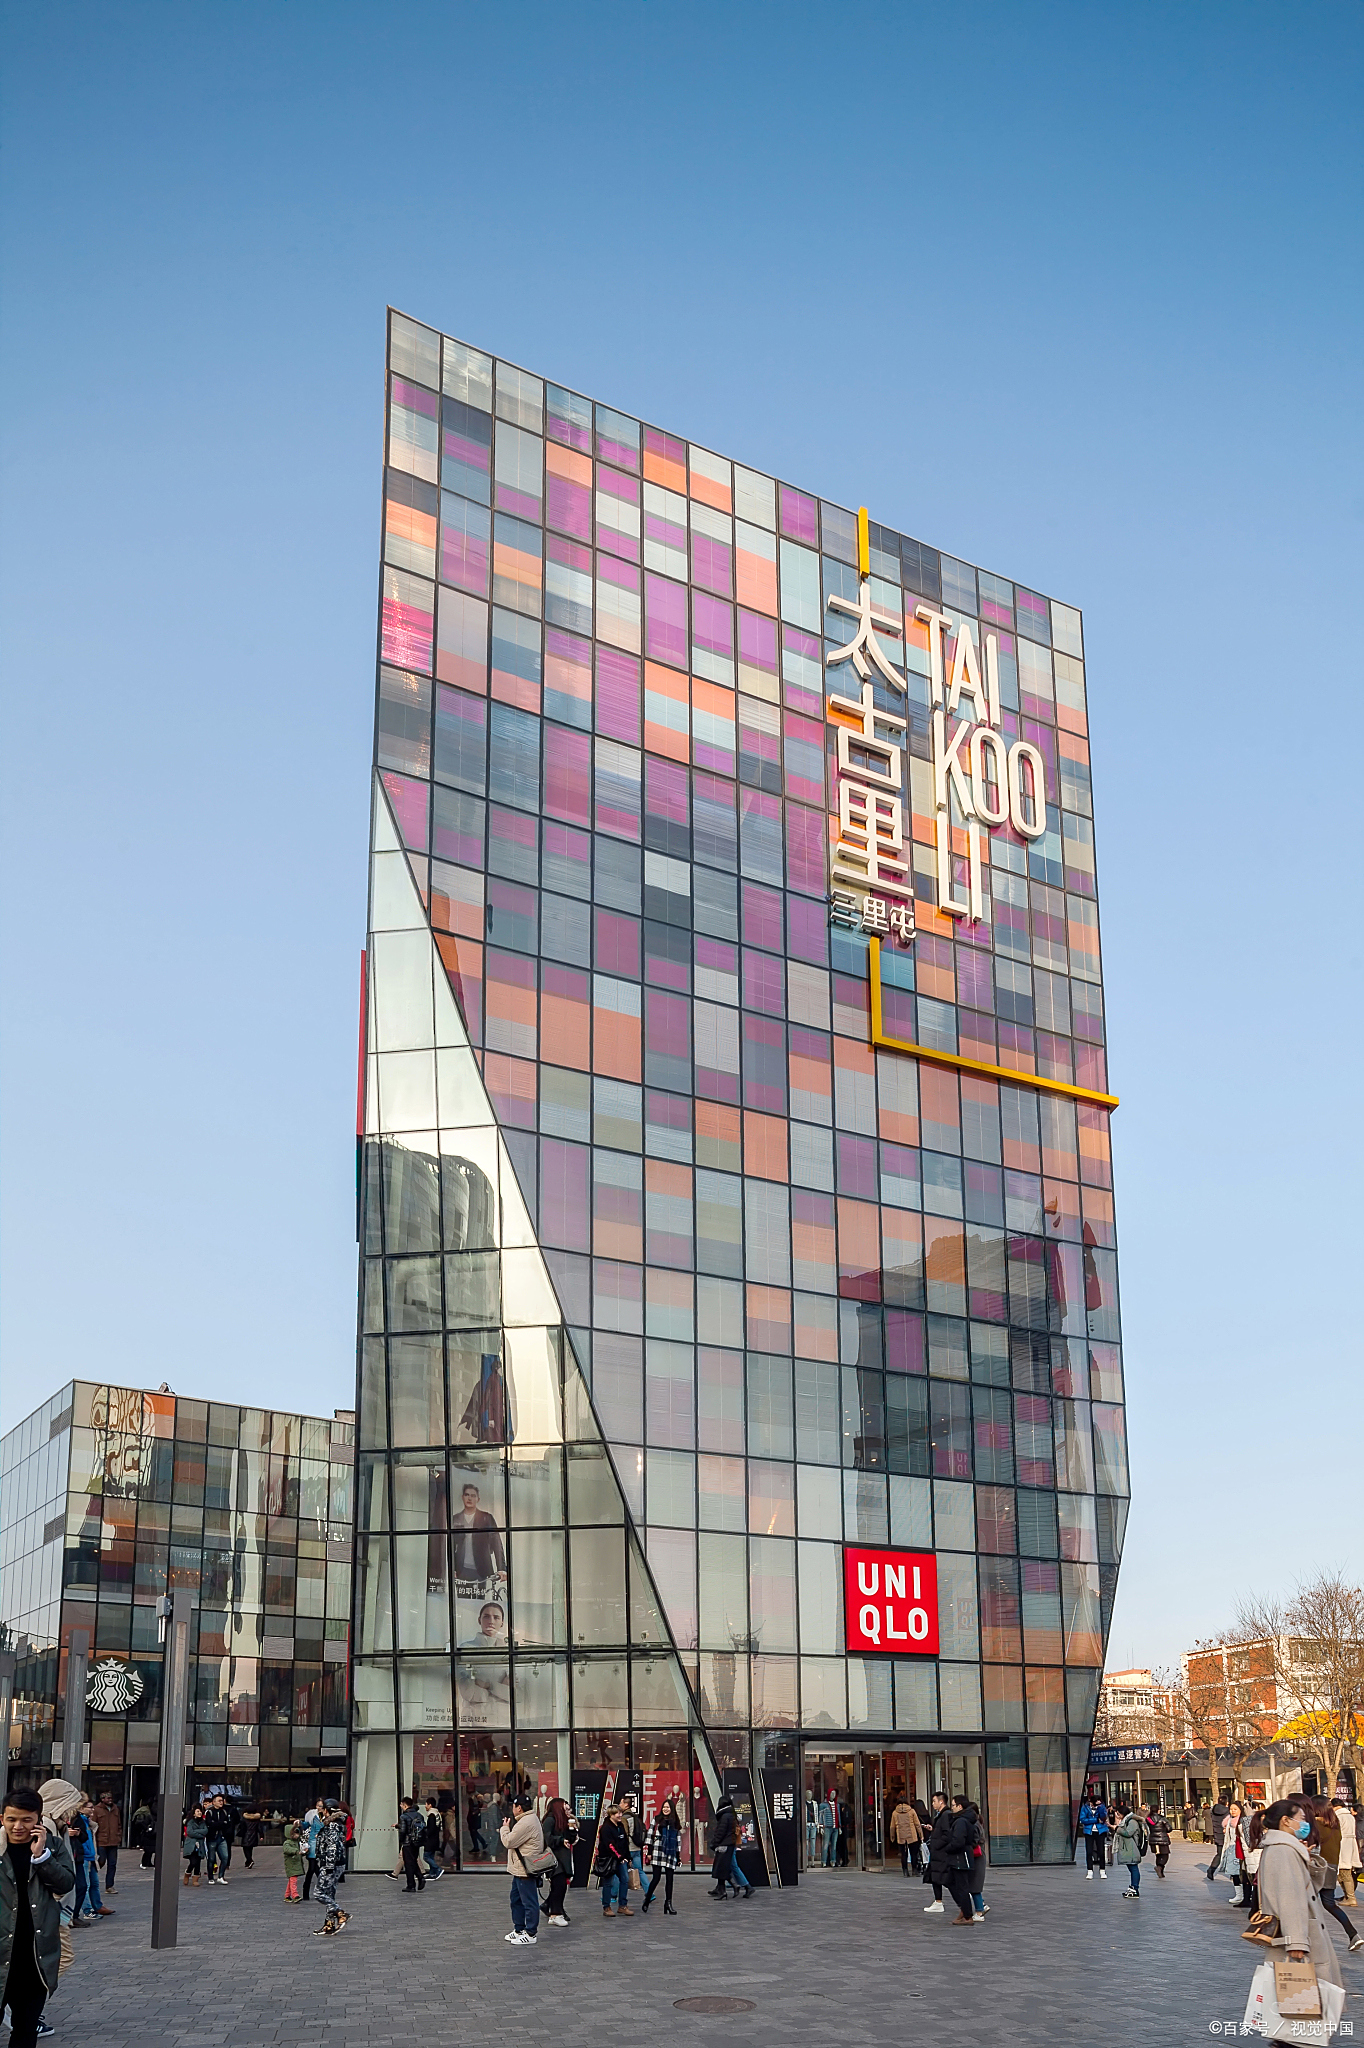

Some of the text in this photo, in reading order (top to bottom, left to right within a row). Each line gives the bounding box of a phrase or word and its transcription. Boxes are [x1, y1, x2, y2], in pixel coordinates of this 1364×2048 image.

[915, 604, 1001, 729] TAI
[826, 582, 914, 897] 太古里
[933, 710, 1047, 839] KOO
[936, 811, 984, 923] LI
[830, 888, 916, 940] 三里屯
[858, 1562, 921, 1599] UNI
[859, 1604, 929, 1644] QLO
[428, 1754, 453, 1763] SALE
